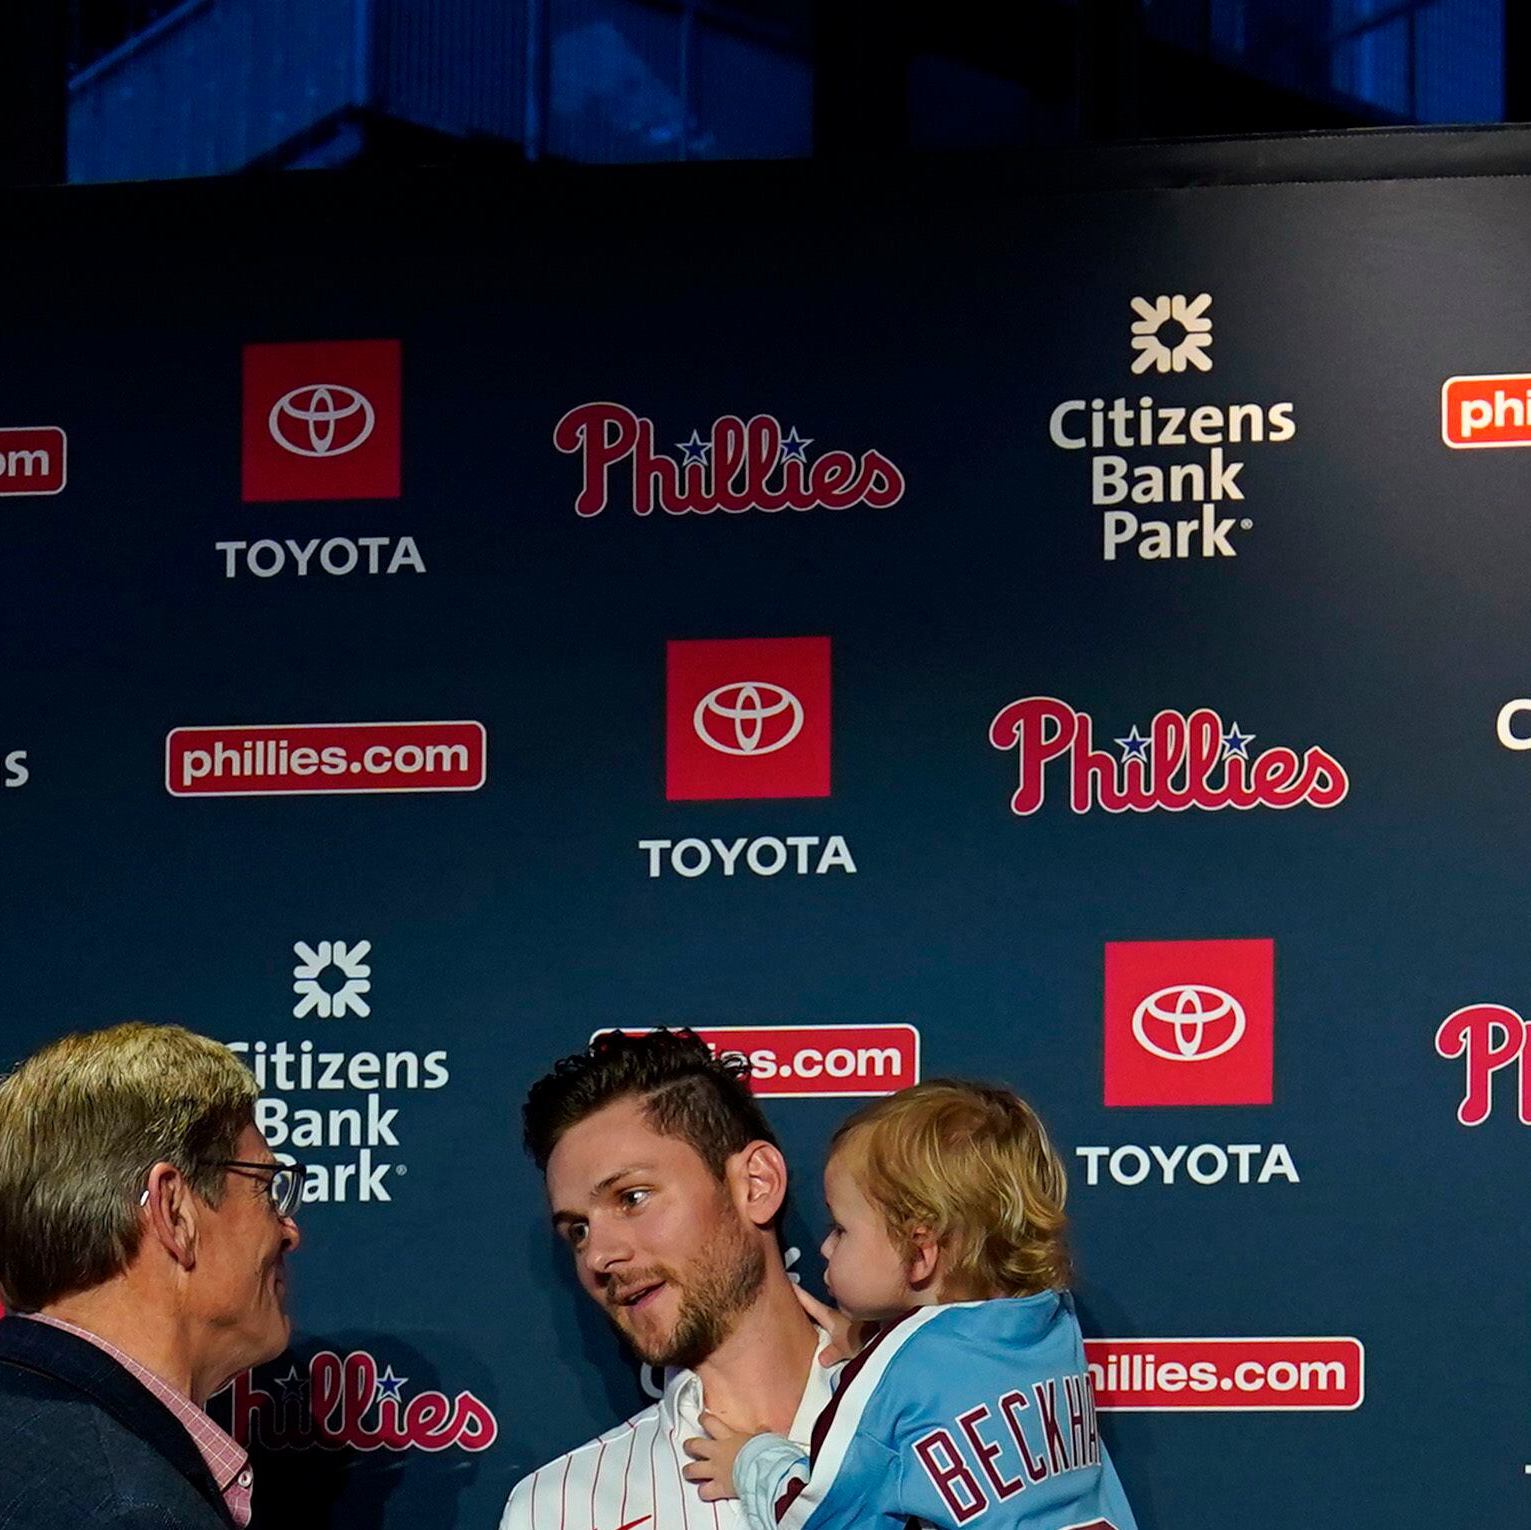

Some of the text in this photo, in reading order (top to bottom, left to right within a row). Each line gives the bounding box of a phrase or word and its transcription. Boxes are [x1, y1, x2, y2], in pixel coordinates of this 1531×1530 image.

[1050, 396, 1296, 450] Citizens
[553, 402, 905, 518] Phillies
[1092, 447, 1245, 506] Bank
[216, 537, 426, 577] TOYOTA
[1104, 503, 1236, 560] Park
[181, 740, 470, 787] phillies.com
[989, 697, 1349, 816] Phillies
[639, 836, 857, 877] TOYOTA
[224, 1040, 450, 1091] itizens
[255, 1093, 400, 1147] Bank
[1076, 1144, 1300, 1185] TOYOTA
[208, 1351, 498, 1452] hillies
